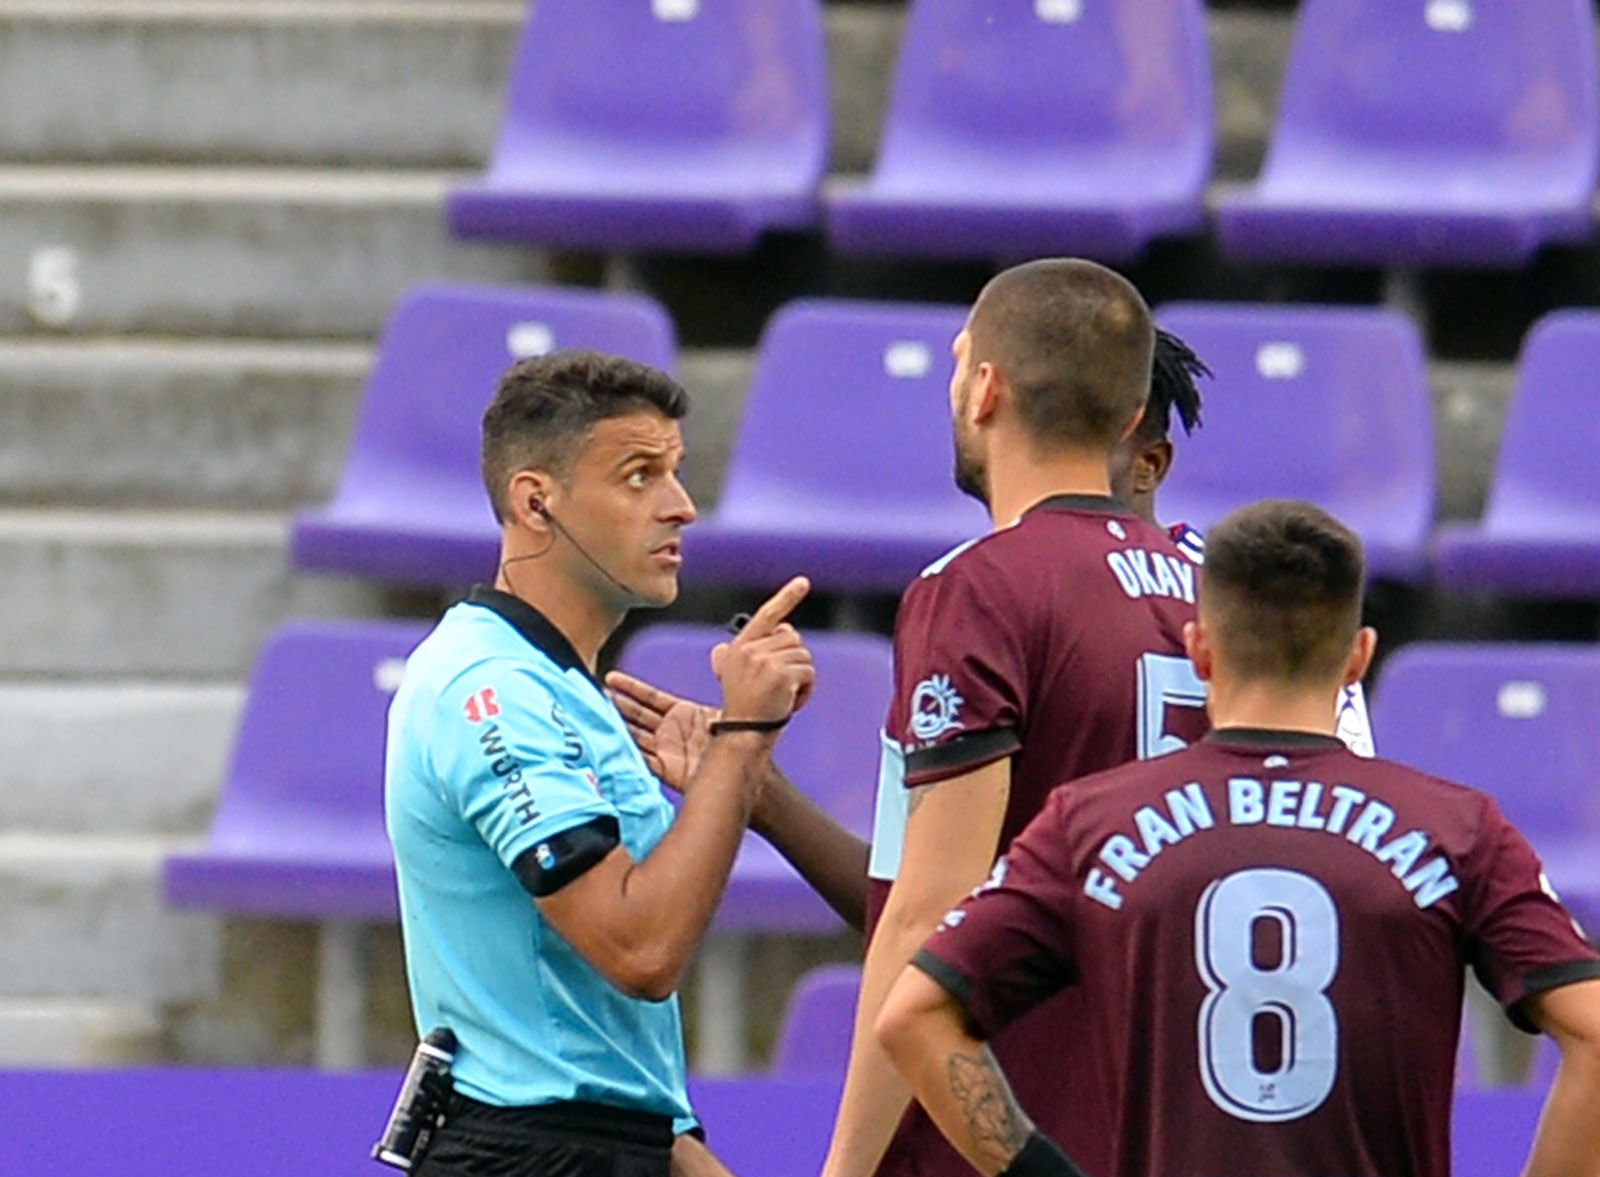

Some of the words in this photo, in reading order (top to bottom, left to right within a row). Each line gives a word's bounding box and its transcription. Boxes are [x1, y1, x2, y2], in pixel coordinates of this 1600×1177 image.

[1107, 549, 1195, 604] OKAY
[1083, 782, 1215, 910] FRAN
[1194, 868, 1339, 1122] 8
